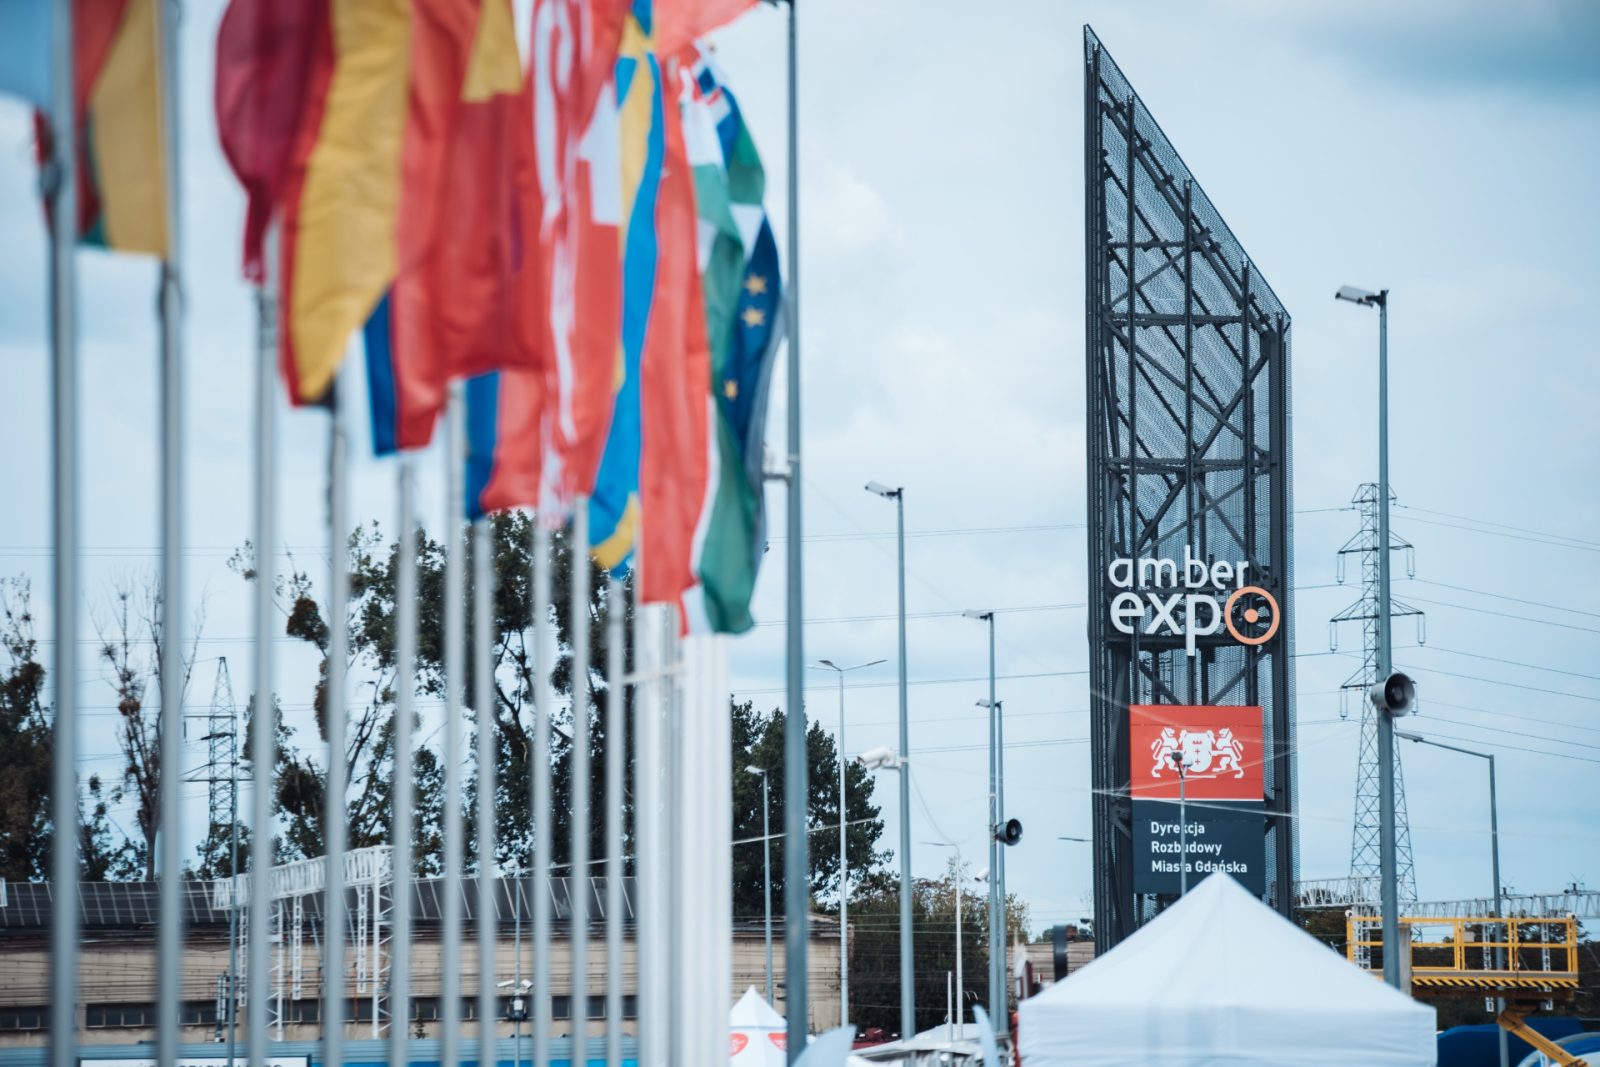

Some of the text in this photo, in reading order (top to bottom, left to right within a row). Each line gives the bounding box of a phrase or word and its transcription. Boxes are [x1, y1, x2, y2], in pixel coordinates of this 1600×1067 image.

[1108, 545, 1249, 589] amber
[1110, 586, 1280, 656] expo
[1151, 859, 1247, 873] Miasa Gdańska
